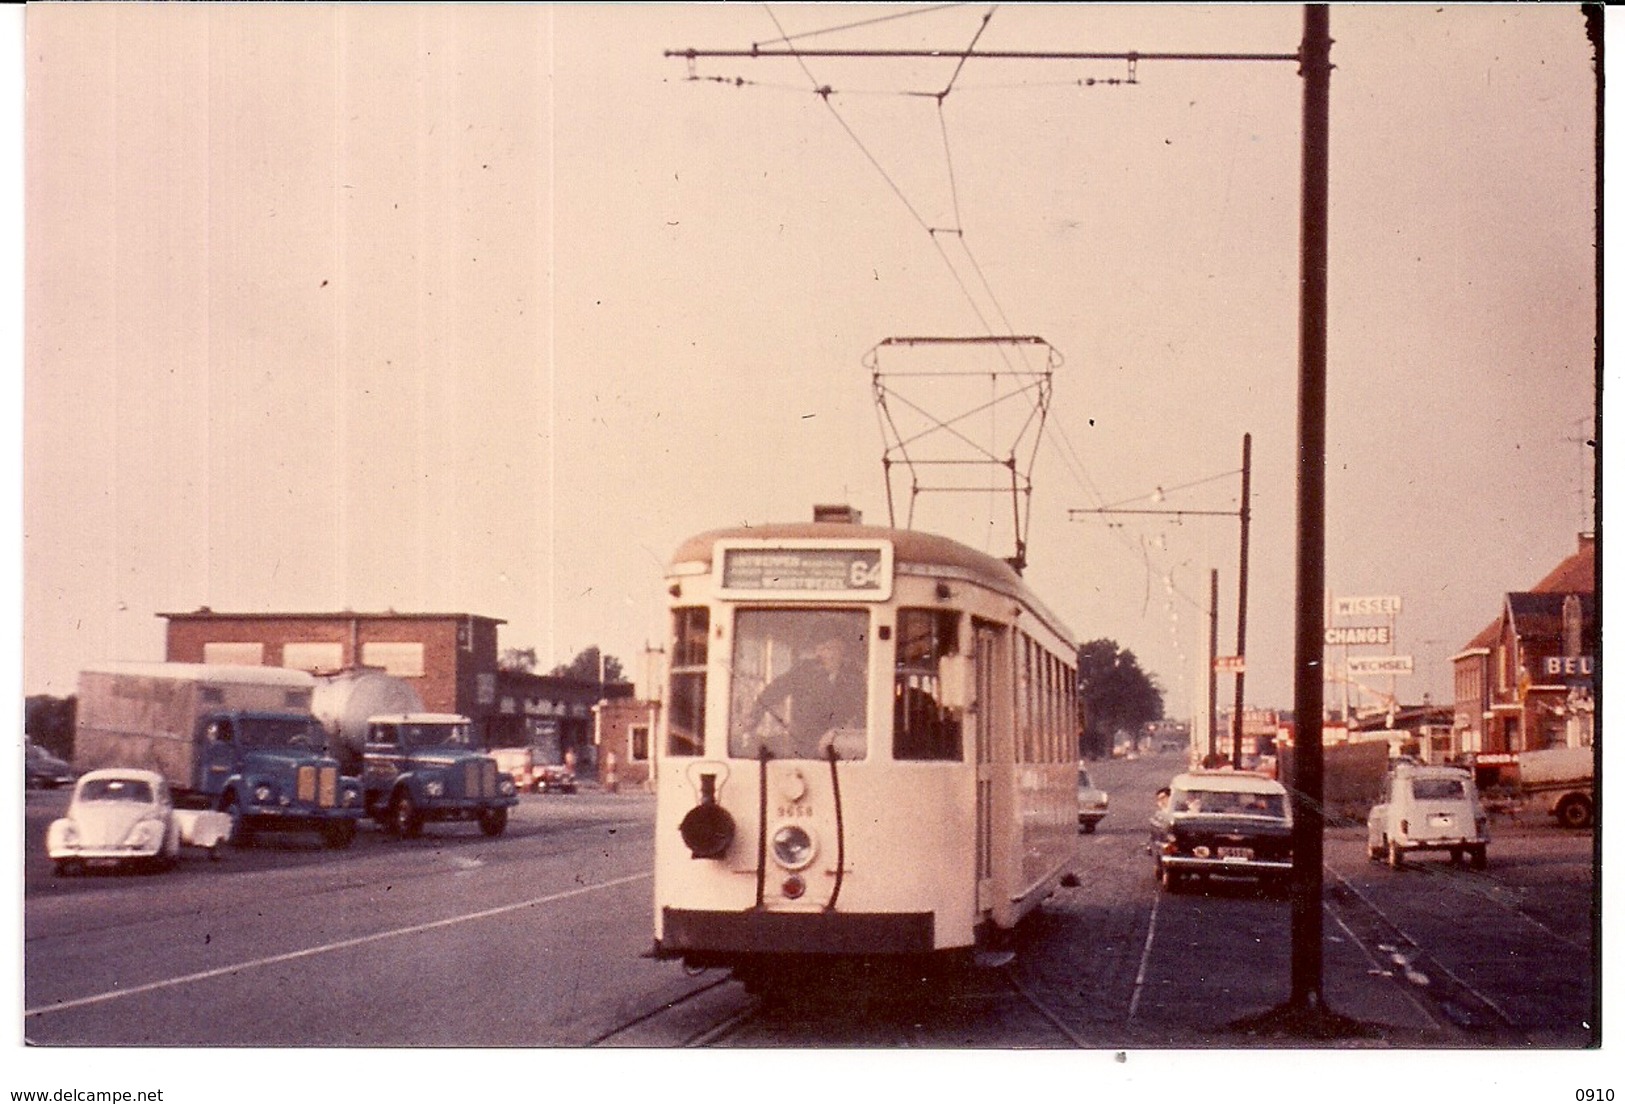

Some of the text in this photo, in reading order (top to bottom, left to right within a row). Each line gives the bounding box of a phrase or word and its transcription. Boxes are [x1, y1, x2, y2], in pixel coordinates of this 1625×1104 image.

[1339, 598, 1399, 613] WISSEL
[1325, 628, 1388, 643] CHANGE
[1349, 659, 1411, 671] WECHSEL
